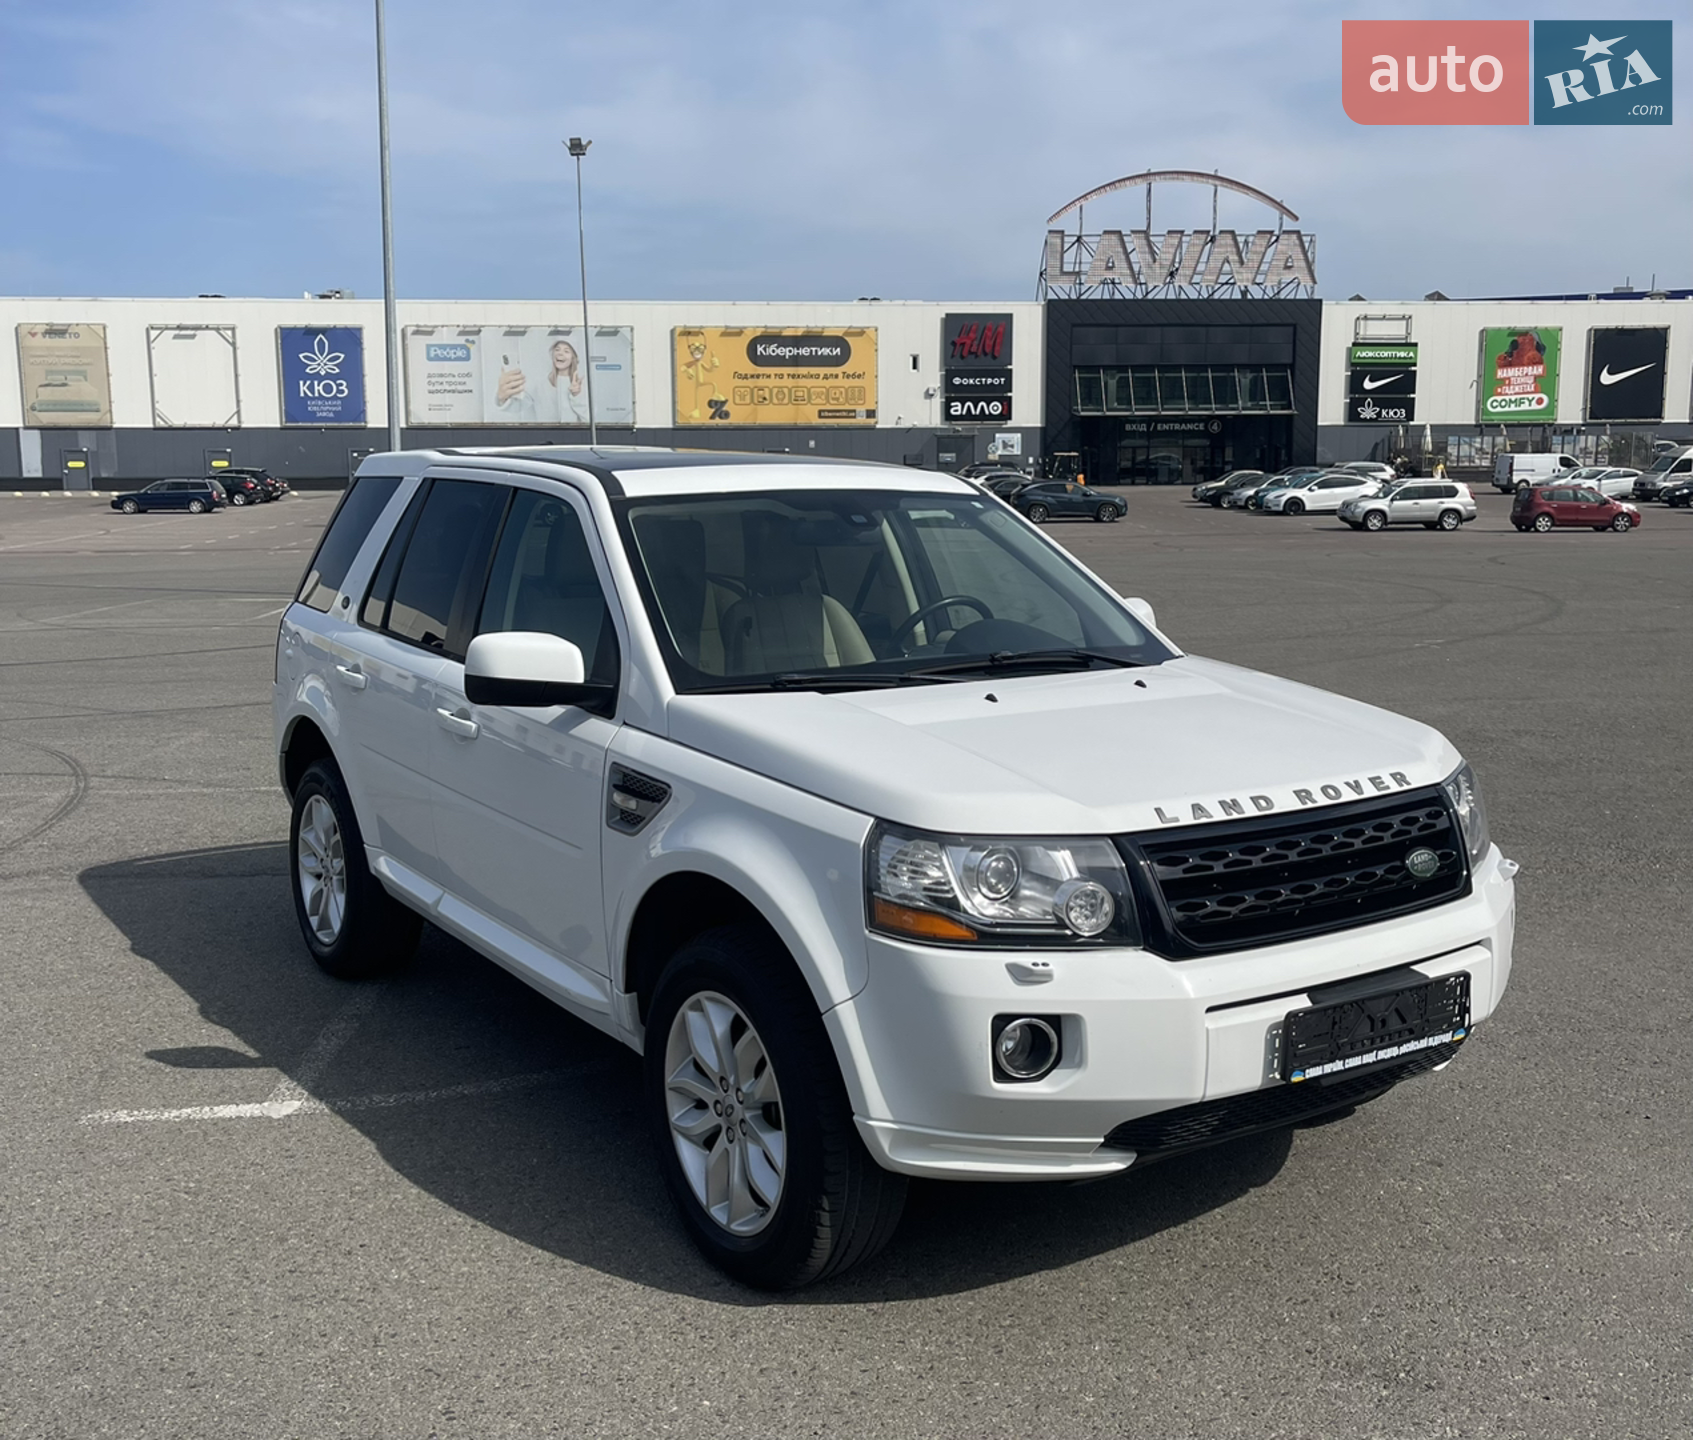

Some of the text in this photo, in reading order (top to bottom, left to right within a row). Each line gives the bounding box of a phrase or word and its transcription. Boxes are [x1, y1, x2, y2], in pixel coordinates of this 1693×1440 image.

[1047, 229, 1318, 285] LAVINA
[953, 321, 1006, 359] H&M
[756, 343, 841, 359] Кібернетики
[732, 371, 771, 380] Гаджети
[786, 371, 820, 380] техніка
[822, 373, 839, 381] для
[841, 371, 866, 380] Тебе!
[1496, 365, 1544, 379] НАМБЕРВАН
[952, 376, 1006, 385] ФОКСТРОТ
[299, 379, 349, 398] КЮЗ
[1490, 396, 1536, 409] COMFY
[1381, 408, 1406, 418] КЮЗ
[1125, 423, 1147, 431] ВХІД
[1153, 771, 1412, 824] LAND ROVER
